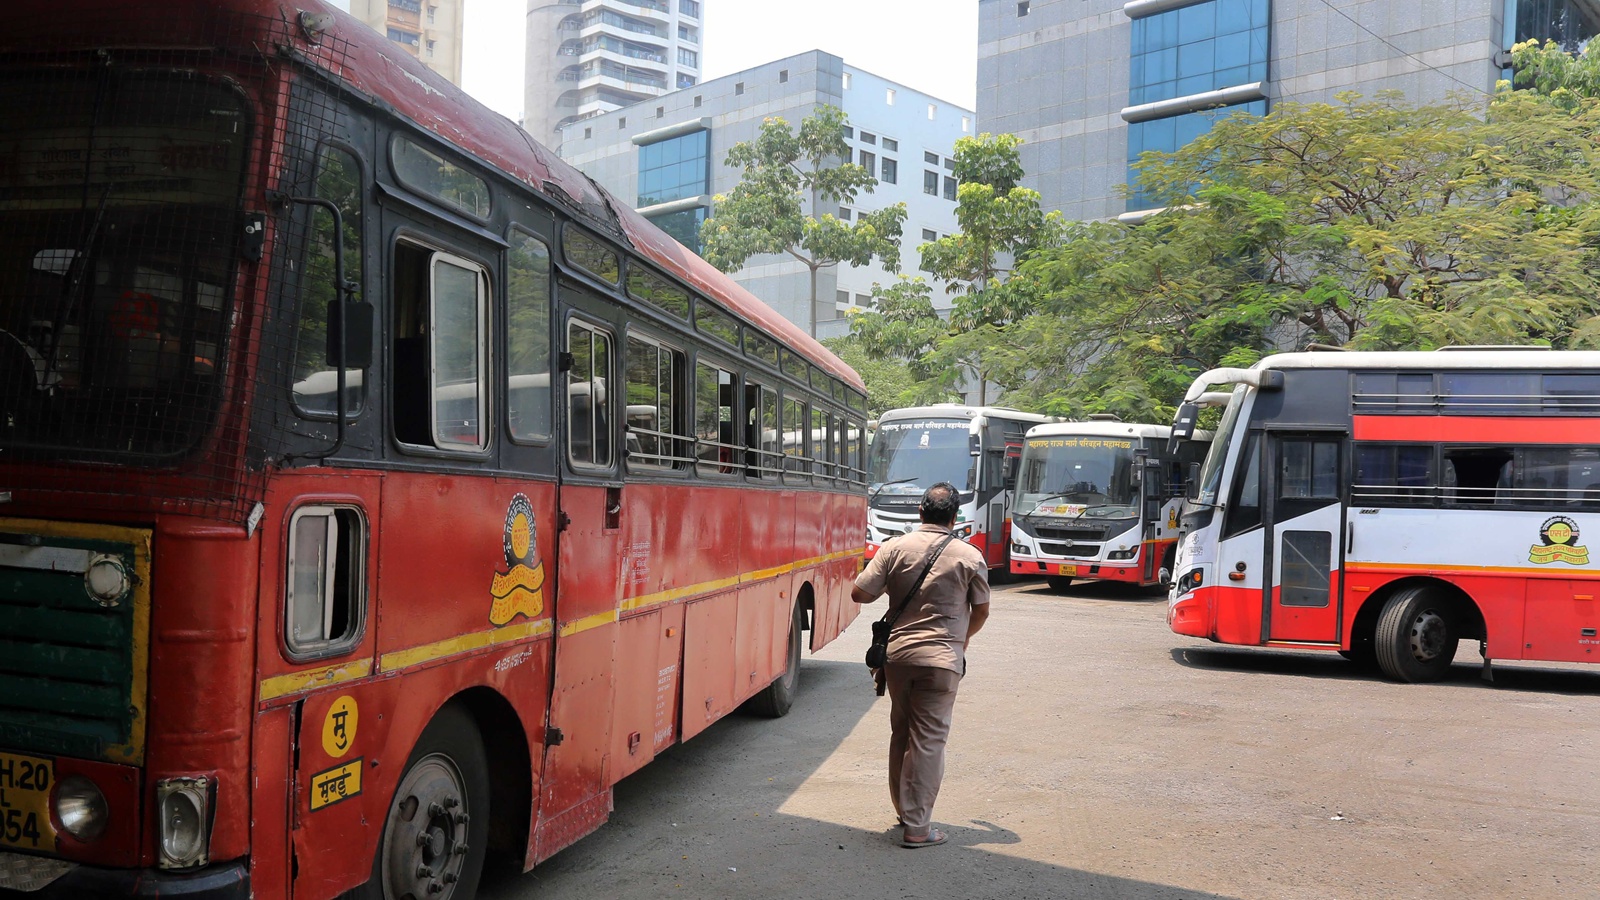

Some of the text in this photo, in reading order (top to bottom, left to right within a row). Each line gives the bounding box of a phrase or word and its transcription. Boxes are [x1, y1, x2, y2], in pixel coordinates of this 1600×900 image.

[925, 420, 945, 430] परिवहन
[1028, 437, 1131, 449] महाराष्ट्र राज्य मार्ग परिवहन महामंडळ
[332, 704, 349, 750] मुं
[317, 767, 352, 803] मुंबई
